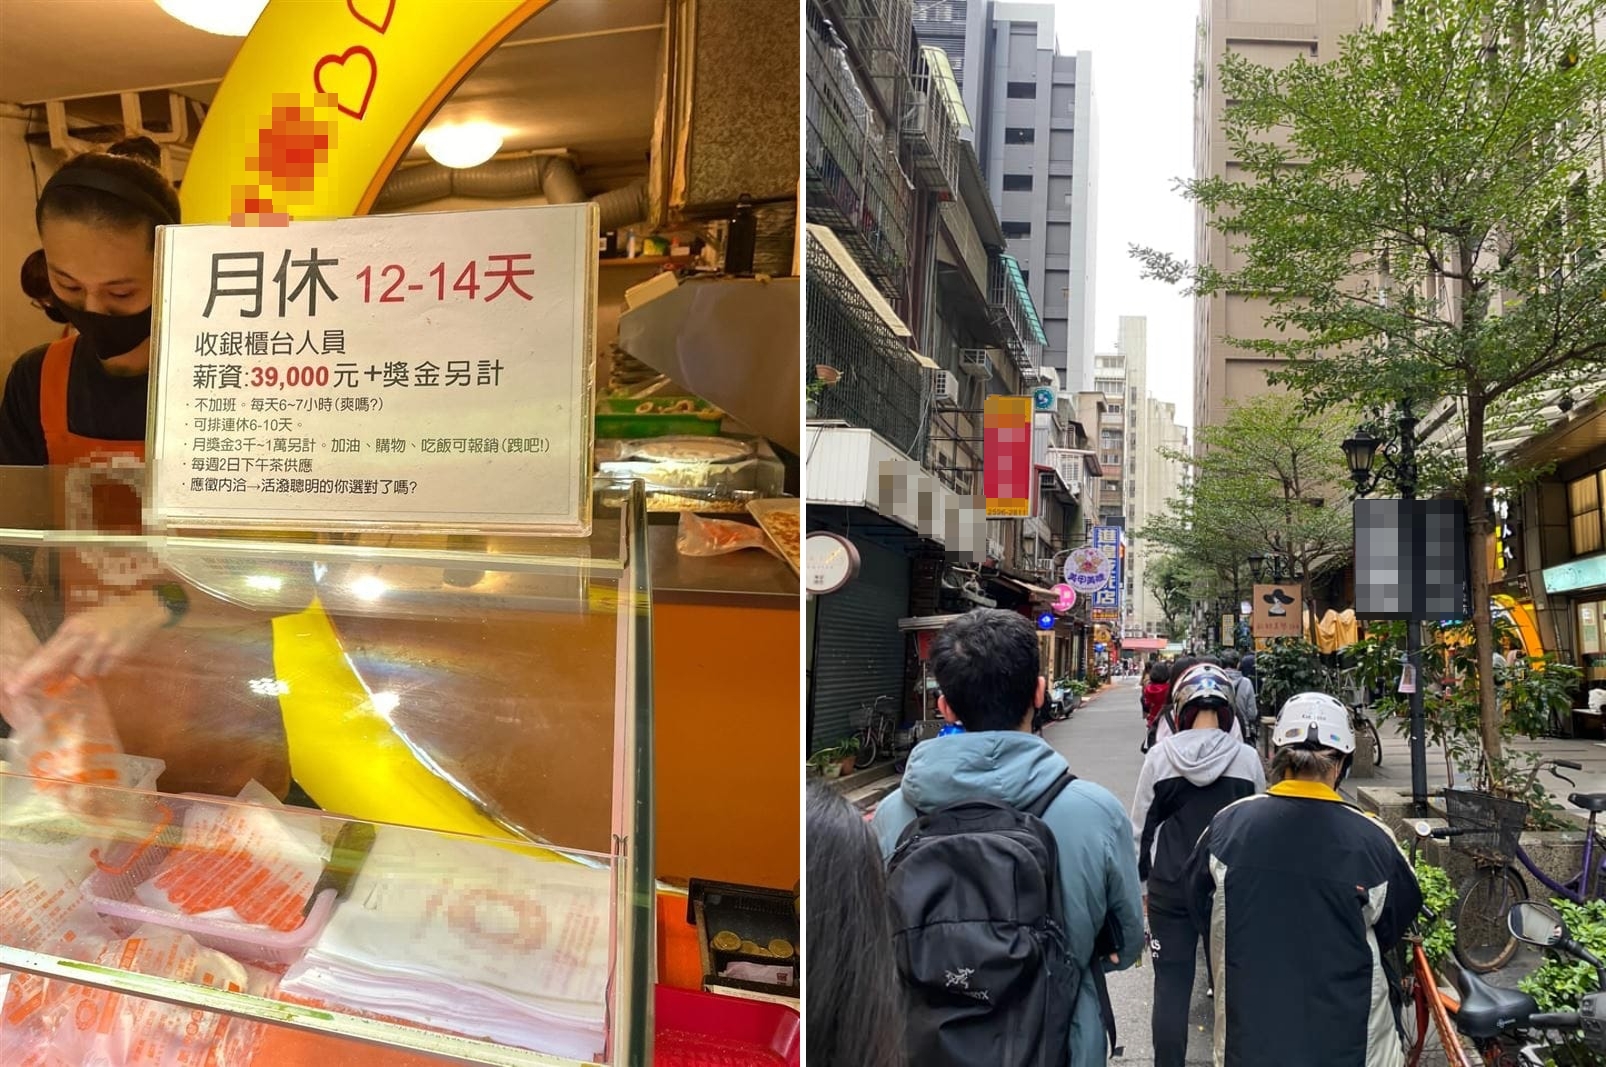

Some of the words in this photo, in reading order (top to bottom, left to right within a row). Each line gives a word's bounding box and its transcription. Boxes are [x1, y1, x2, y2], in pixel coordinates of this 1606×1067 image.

[202, 247, 340, 319] 月休
[355, 253, 535, 304] 12-14天
[194, 329, 346, 357] 收銀櫃台人員
[191, 457, 313, 473] 每週2日下午茶供應
